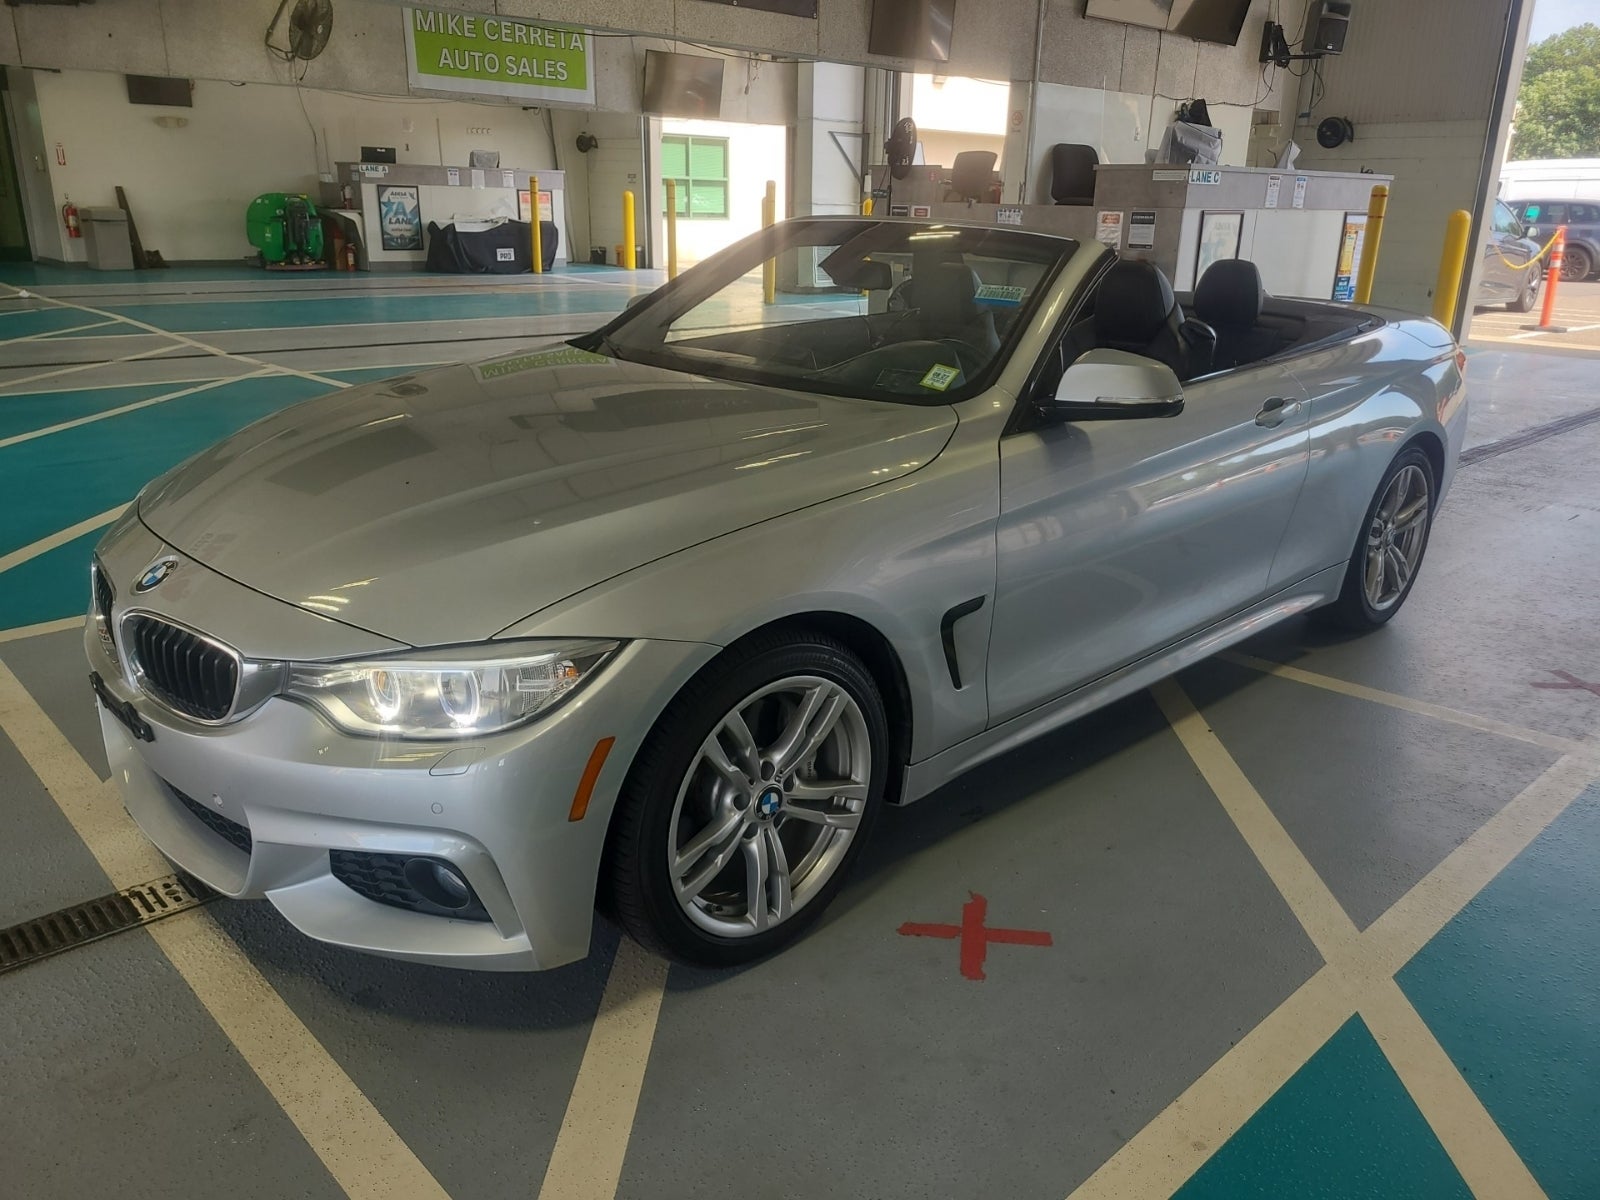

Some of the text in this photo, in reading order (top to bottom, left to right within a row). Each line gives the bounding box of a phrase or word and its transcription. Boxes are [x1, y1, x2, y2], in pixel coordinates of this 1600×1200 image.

[415, 9, 584, 52] MIKE CERRETA
[438, 48, 568, 81] AUTO SALES
[360, 165, 380, 173] LANE
[1190, 171, 1212, 183] LANE
[1213, 172, 1220, 183] C
